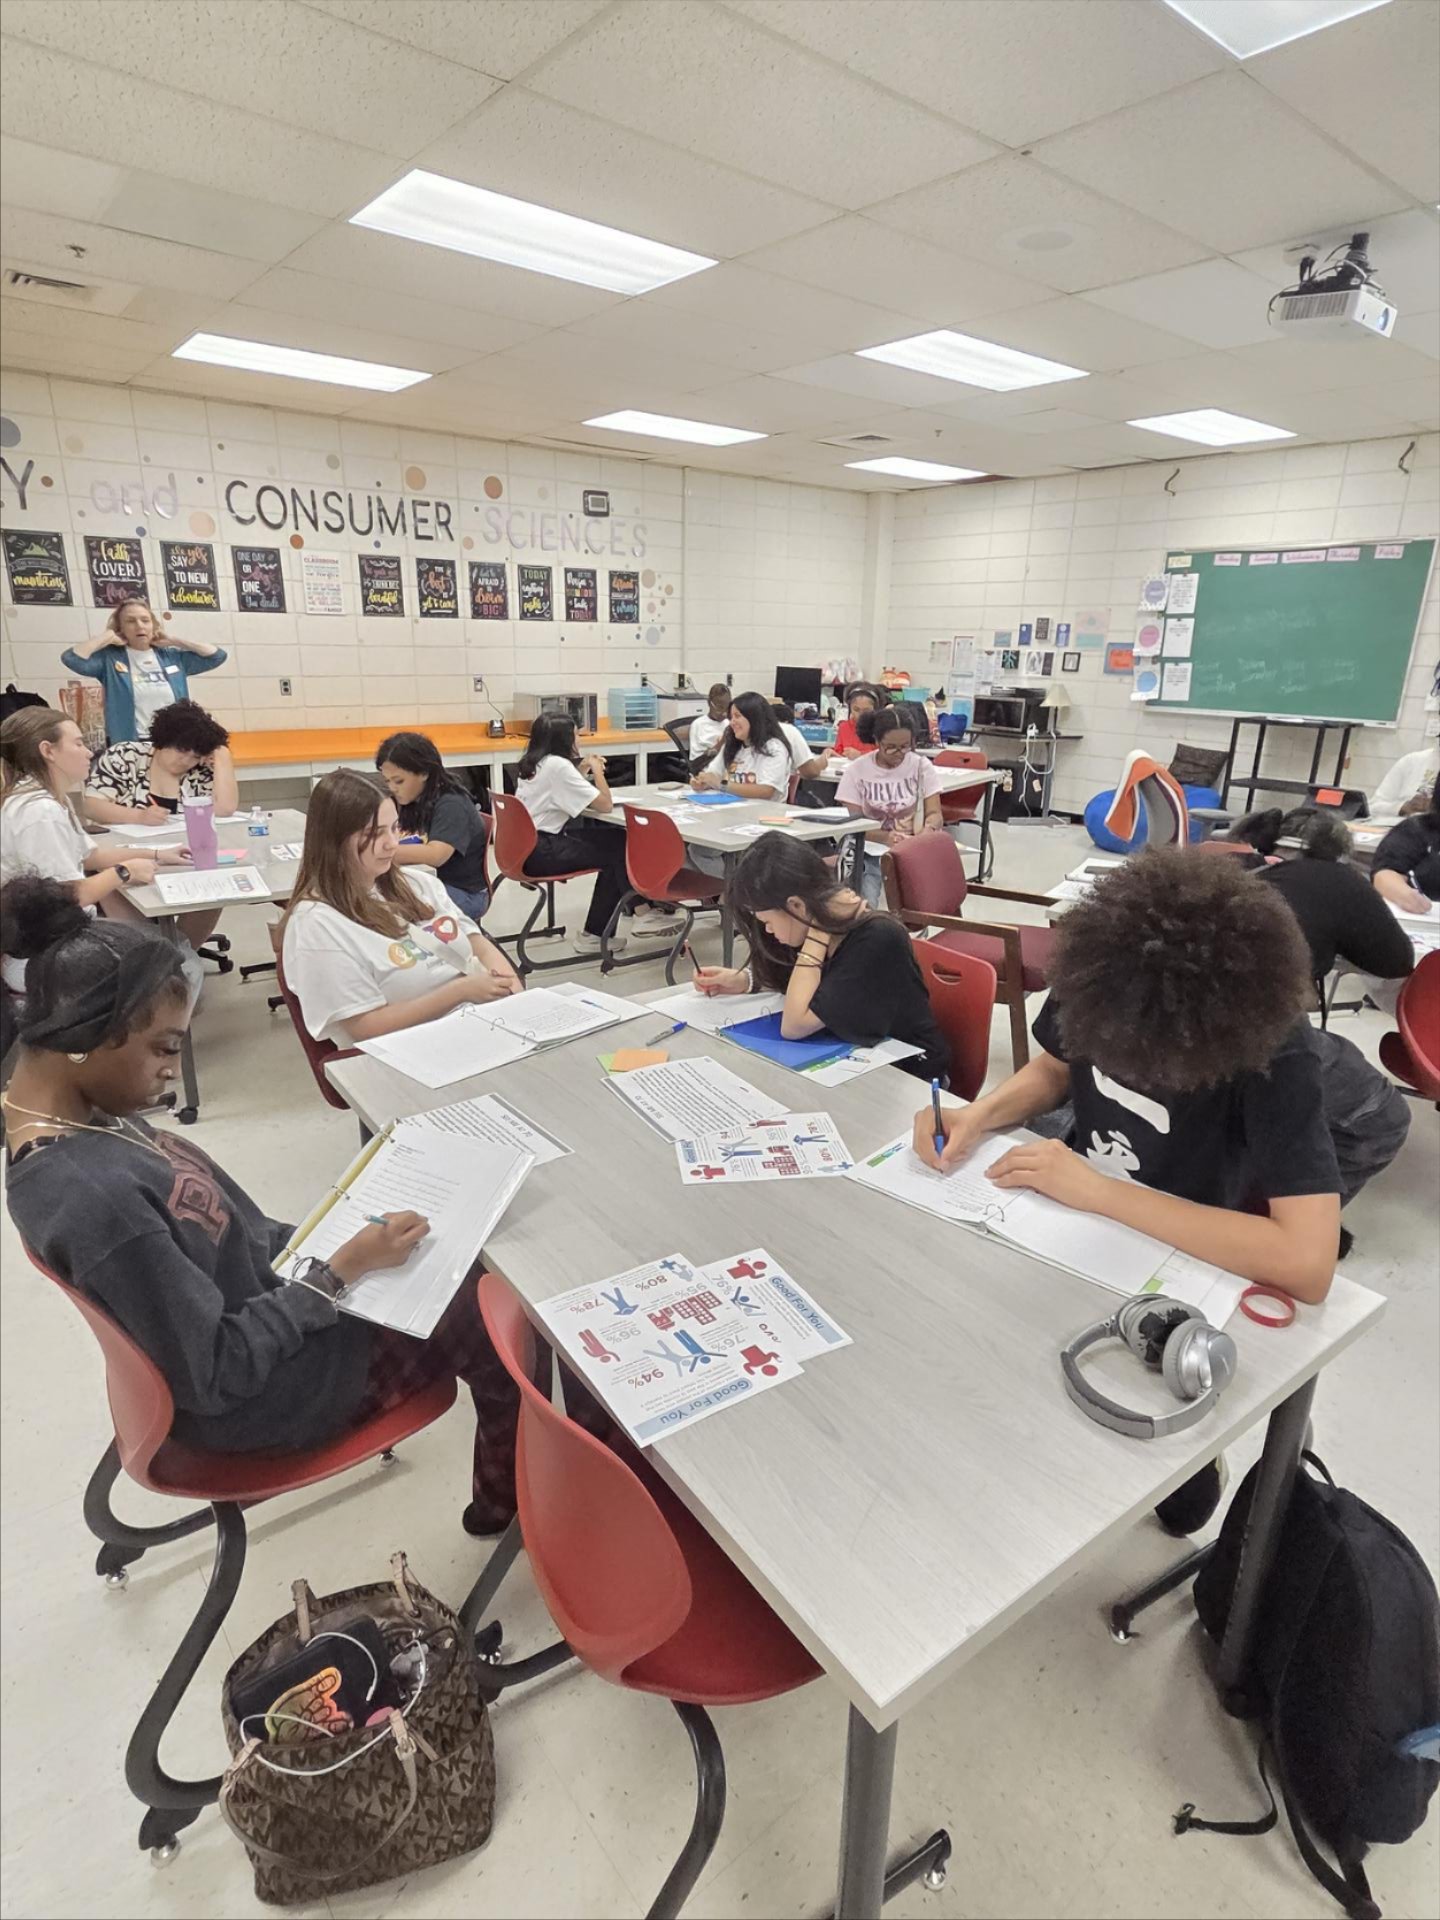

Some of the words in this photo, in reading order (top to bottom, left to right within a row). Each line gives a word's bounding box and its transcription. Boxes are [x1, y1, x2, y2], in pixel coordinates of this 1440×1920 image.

[226, 480, 454, 541] CONSUMER
[482, 506, 648, 558] SCIENCES
[170, 554, 188, 568] SAY
[174, 571, 186, 584] TO
[188, 572, 208, 585] NEW
[523, 569, 548, 580] TODAY
[242, 581, 260, 593] ONE
[482, 604, 499, 615] BIG
[635, 1275, 668, 1291] 80%
[569, 1299, 604, 1315] 78%
[771, 1277, 797, 1299] Good
[794, 1298, 810, 1315] For
[806, 1312, 824, 1330] You
[606, 1327, 641, 1344] 96%
[710, 1334, 746, 1352] 76%
[627, 1368, 664, 1389] 94%
[714, 1379, 749, 1400] Good
[688, 1399, 713, 1412] For
[659, 1409, 689, 1425] You
